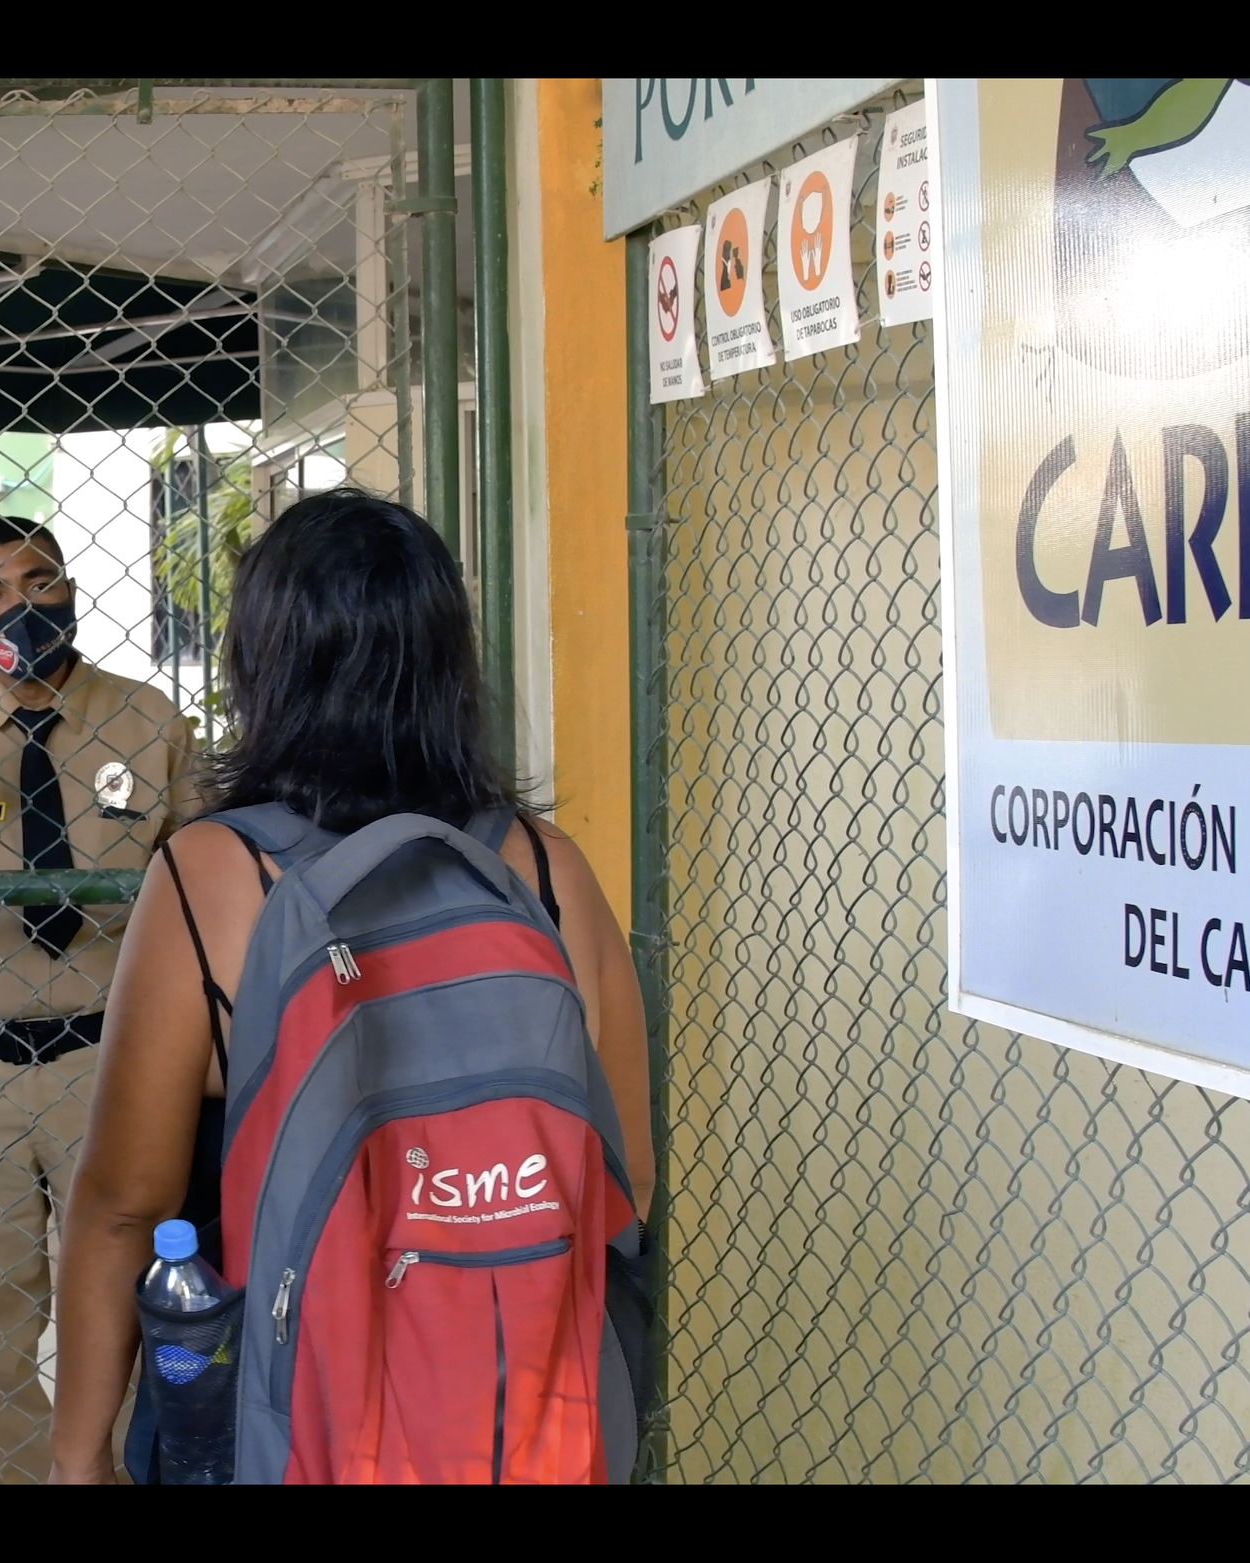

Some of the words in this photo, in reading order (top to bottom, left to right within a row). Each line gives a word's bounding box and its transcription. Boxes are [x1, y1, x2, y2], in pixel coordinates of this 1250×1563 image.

[790, 308, 802, 323] USO
[802, 296, 841, 319] OBLIGATORIO
[711, 331, 730, 347] CONTROL
[730, 321, 761, 340] OBLIGATORIO
[796, 328, 804, 340] DE
[804, 317, 837, 337] TAPABOCAS
[718, 350, 724, 362] DE
[724, 342, 756, 360] TEMPERATURA
[1016, 412, 1250, 629] CAR
[990, 783, 1236, 874] CORPORACIÓN
[1124, 903, 1190, 980] DEL
[406, 1147, 547, 1208] isme
[407, 1212, 452, 1223] International
[452, 1215, 480, 1224] Society
[482, 1213, 494, 1221] for
[494, 1205, 529, 1220] Microbial
[530, 1201, 560, 1211] Ecology
